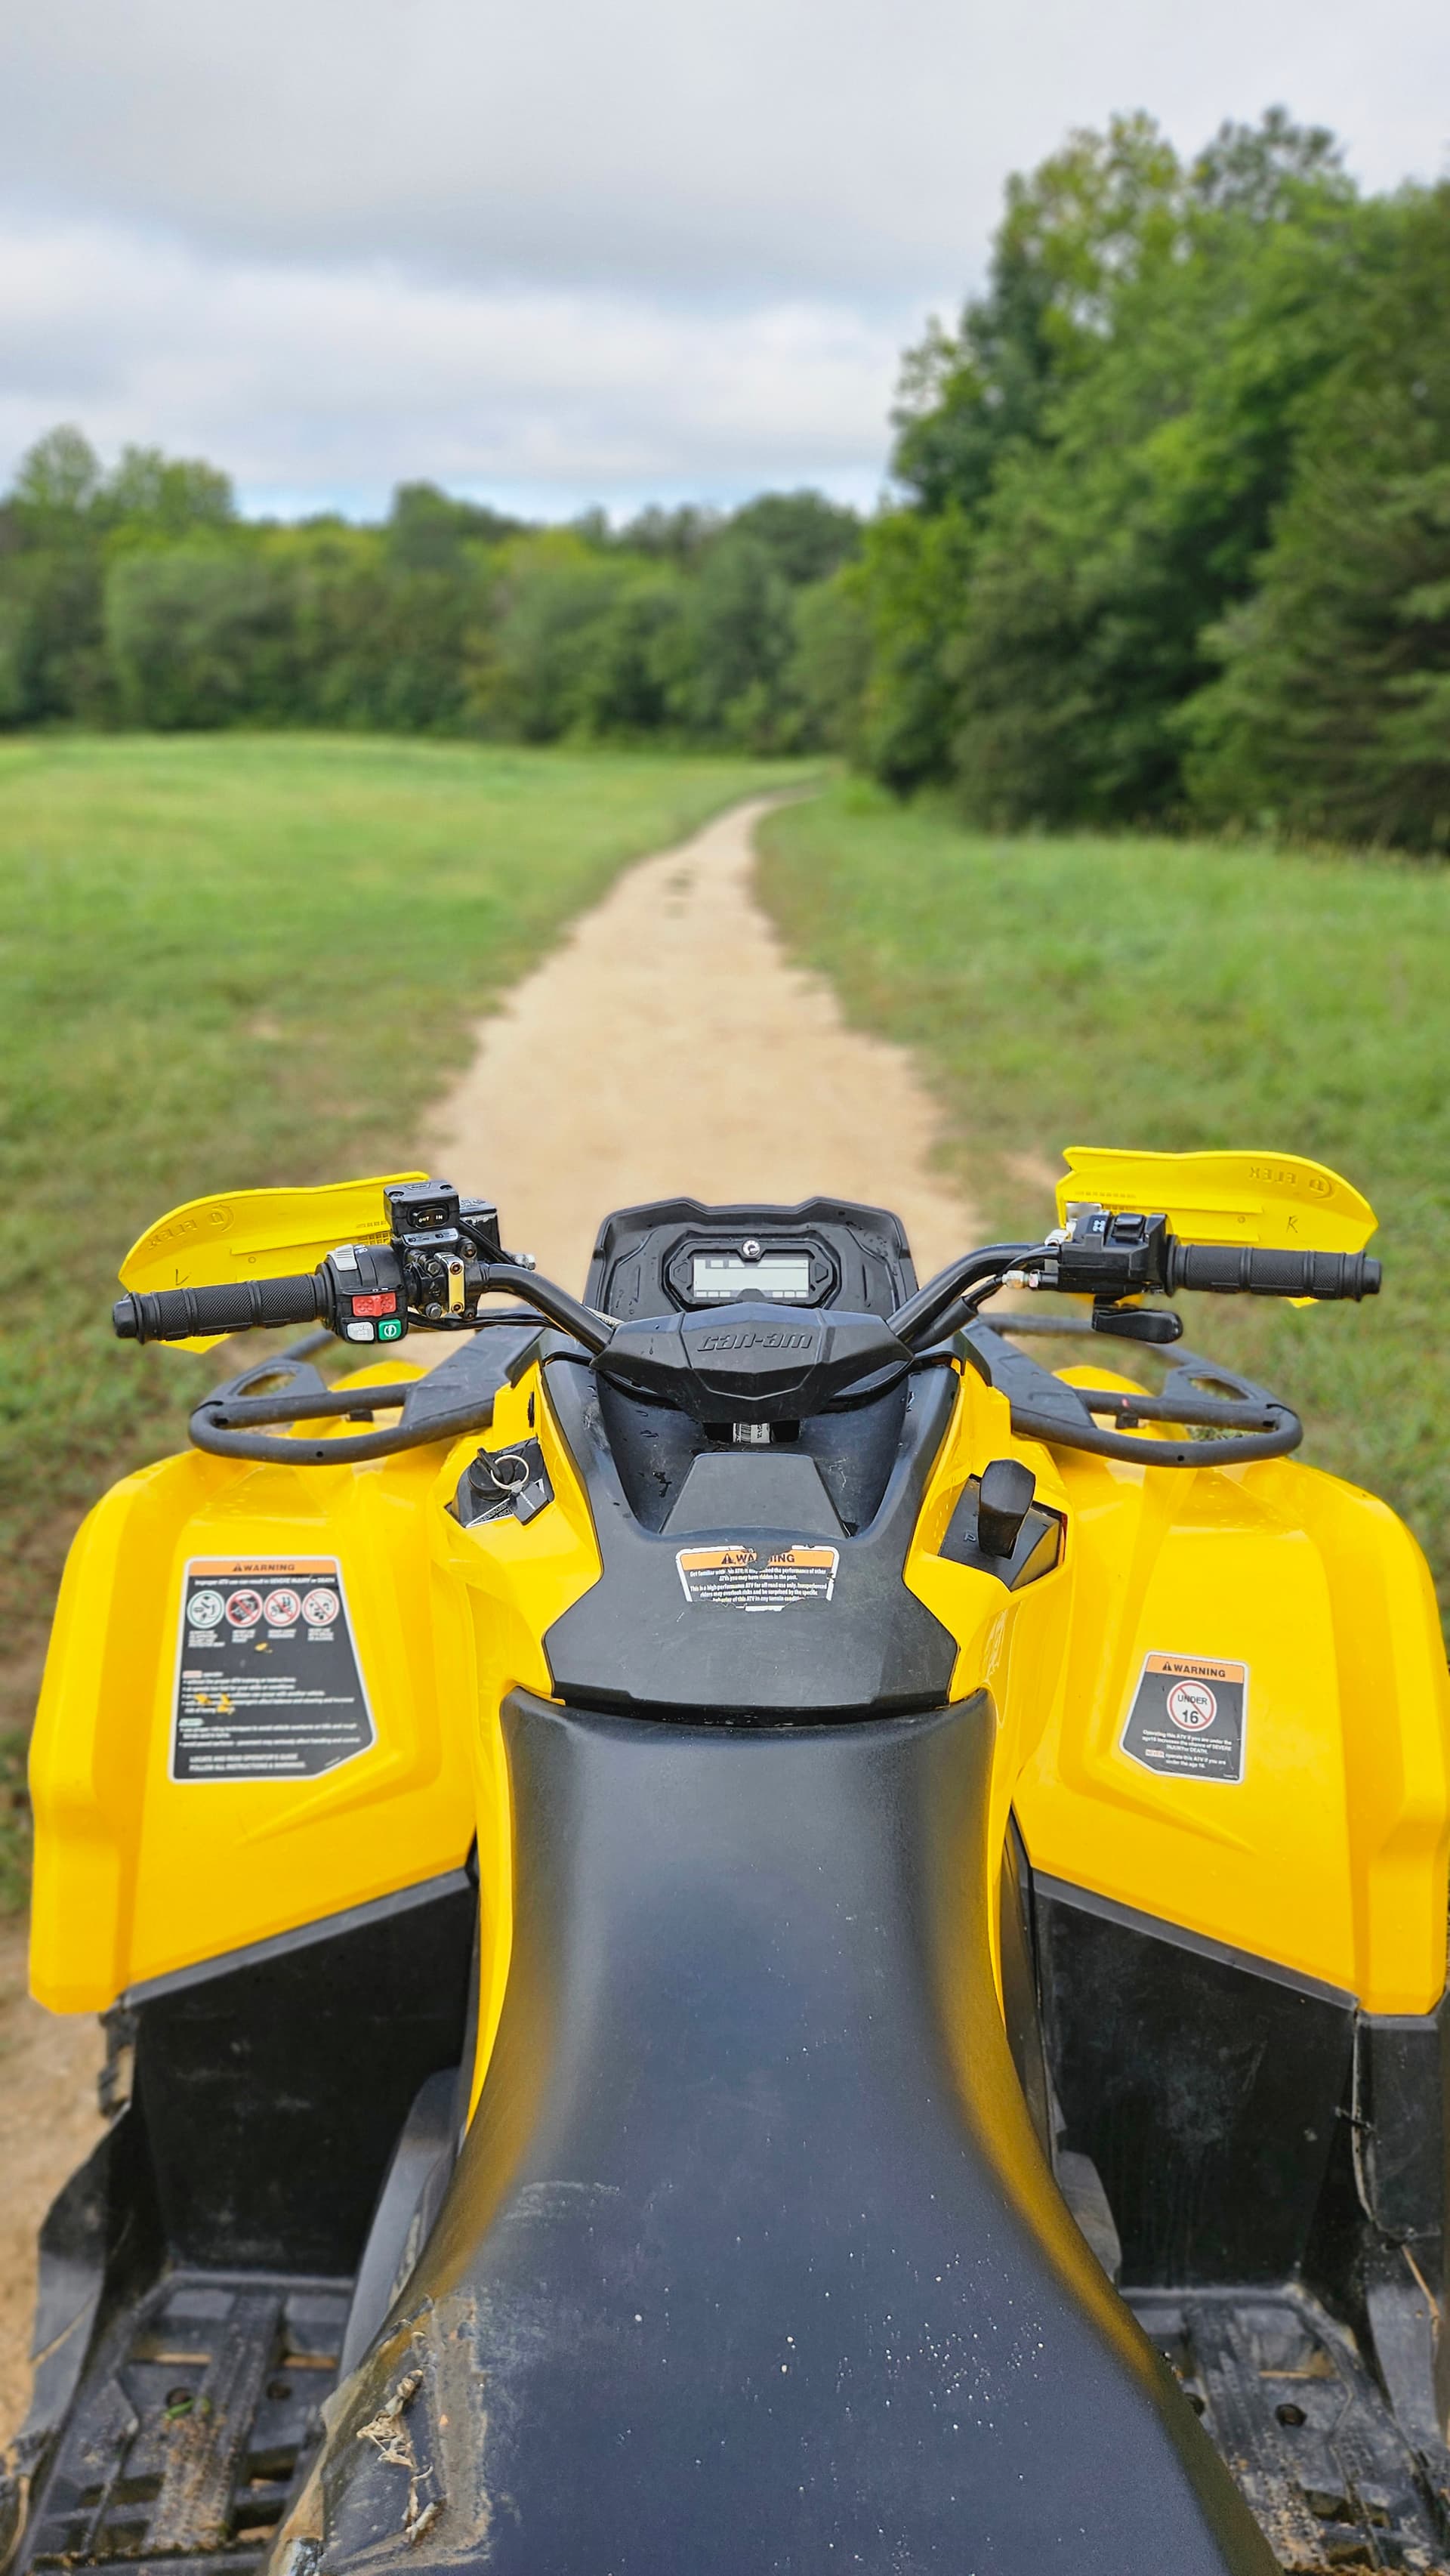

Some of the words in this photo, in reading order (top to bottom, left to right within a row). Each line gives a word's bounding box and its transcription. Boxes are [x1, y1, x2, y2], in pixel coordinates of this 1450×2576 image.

[696, 1333, 813, 1352] can-am
[736, 1554, 794, 1564] WAING
[1174, 1664, 1226, 1677] WARNING
[1178, 1695, 1208, 1704] UNDER
[1183, 1710, 1199, 1724] 16
